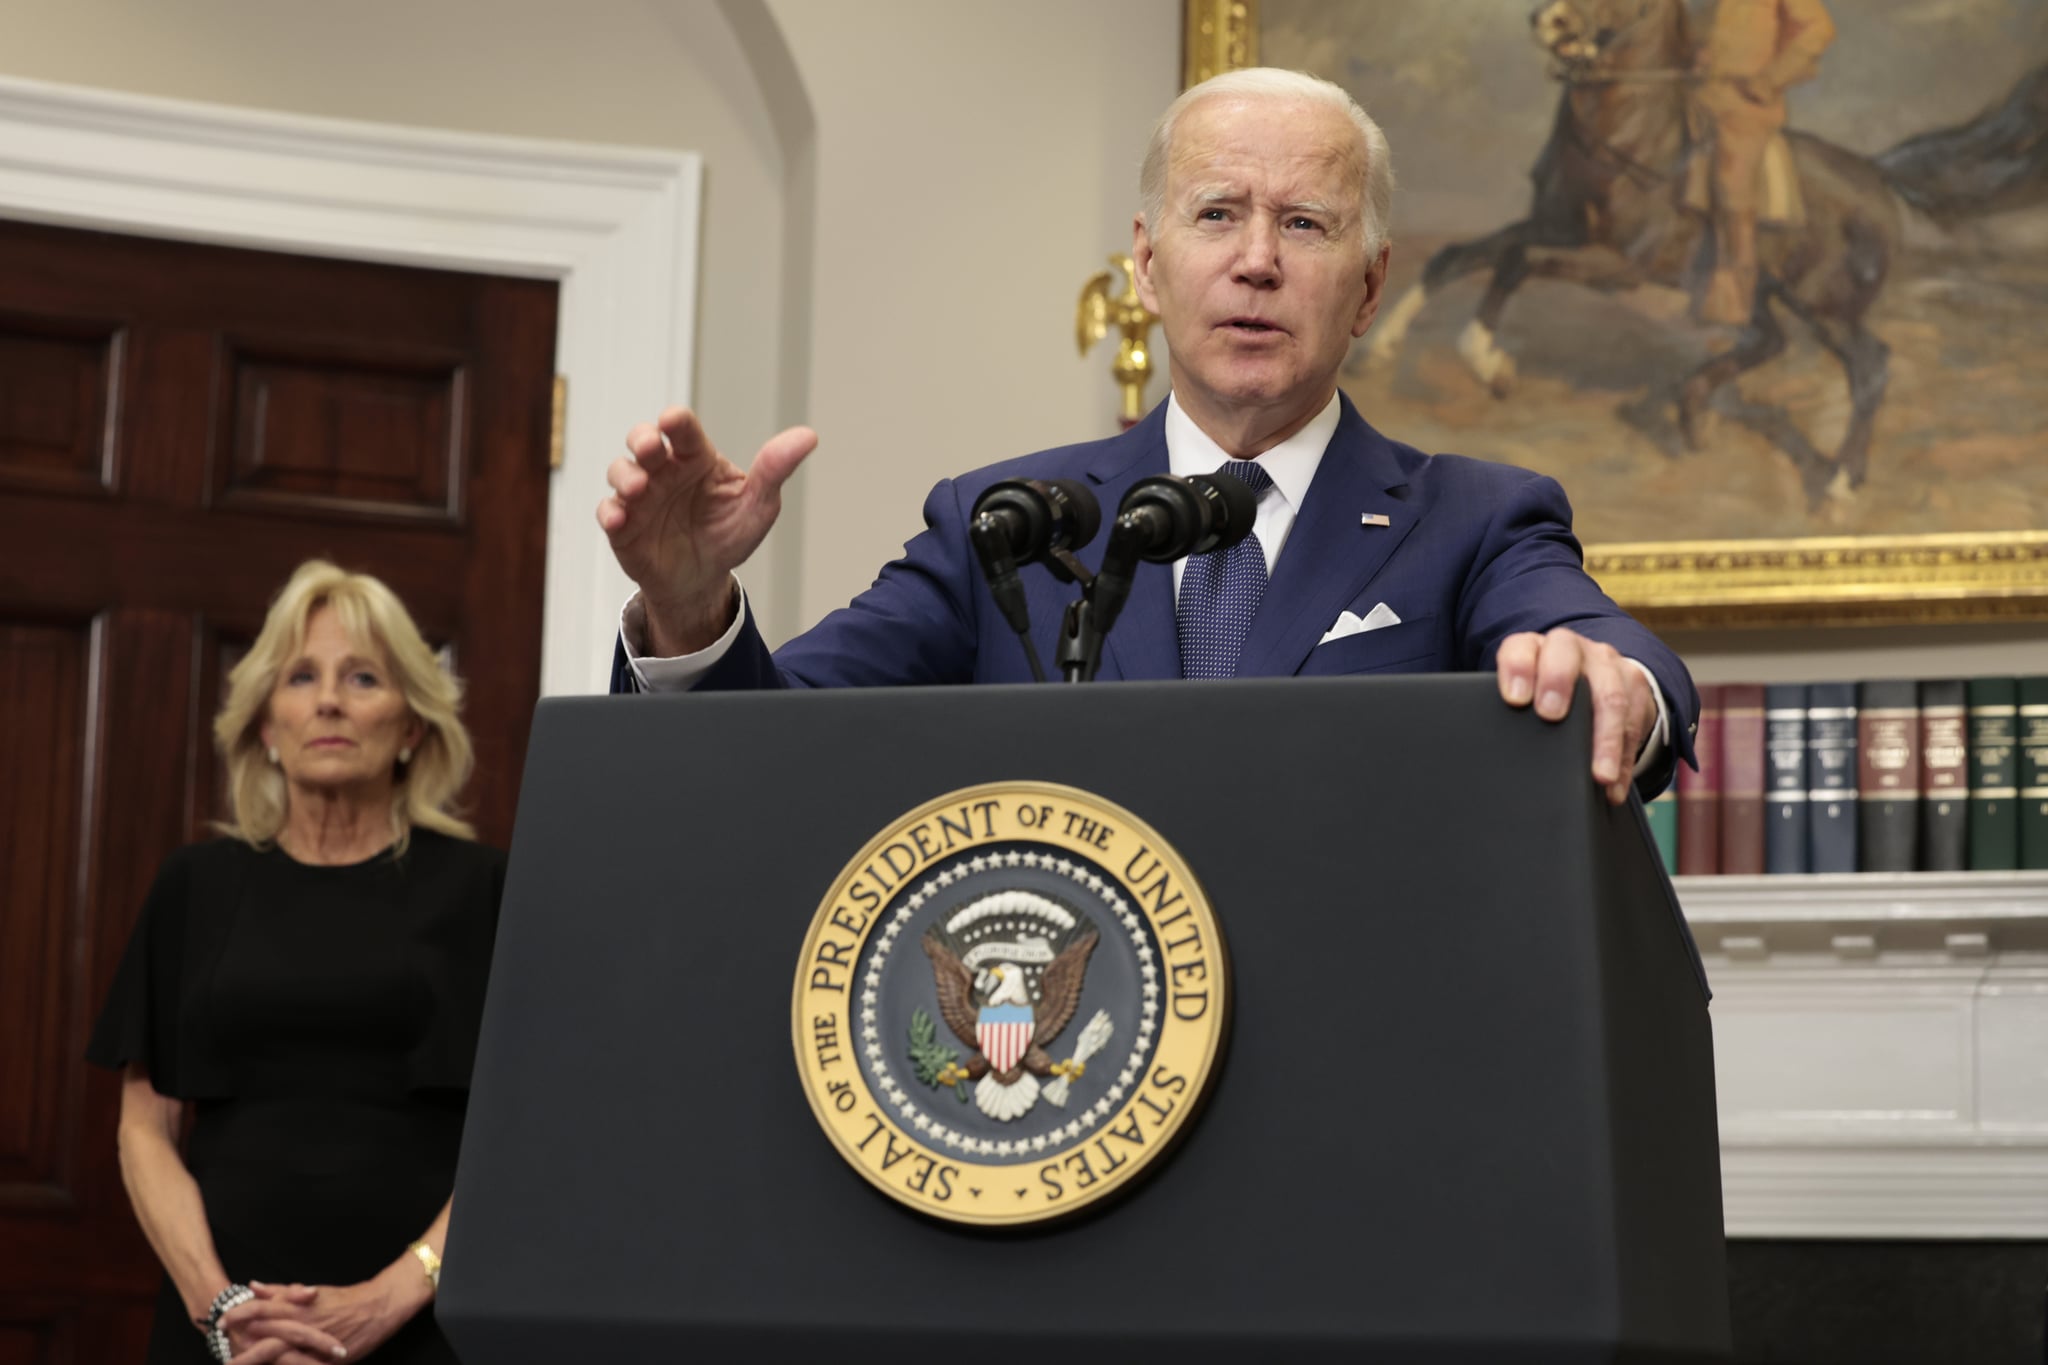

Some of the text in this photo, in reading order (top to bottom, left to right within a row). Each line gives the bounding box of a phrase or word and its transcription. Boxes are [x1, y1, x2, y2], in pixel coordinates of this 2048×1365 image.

[809, 799, 1209, 1202] SEAL OF THE PRESIDENT OF THE UNITED STATES
